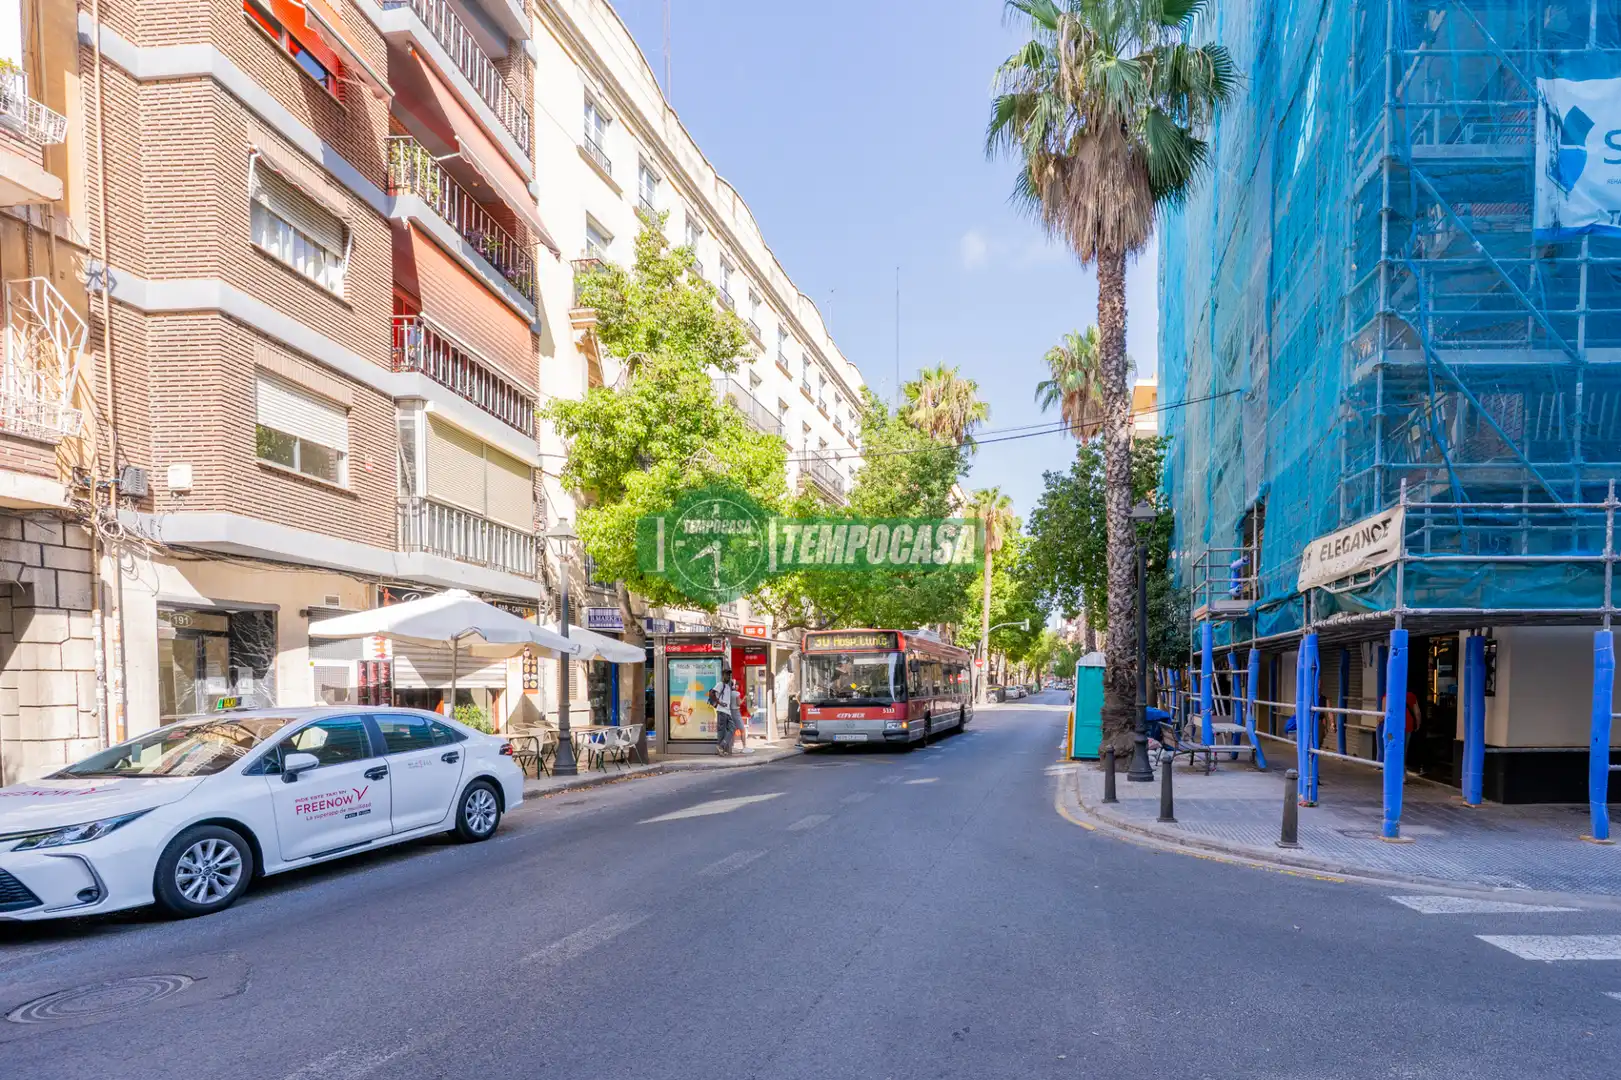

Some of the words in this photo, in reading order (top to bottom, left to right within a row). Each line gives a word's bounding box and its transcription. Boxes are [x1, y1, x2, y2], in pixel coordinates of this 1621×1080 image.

[1320, 517, 1392, 562] ELEGANCE
[173, 616, 189, 626] 191
[296, 795, 354, 815] FREENOW
